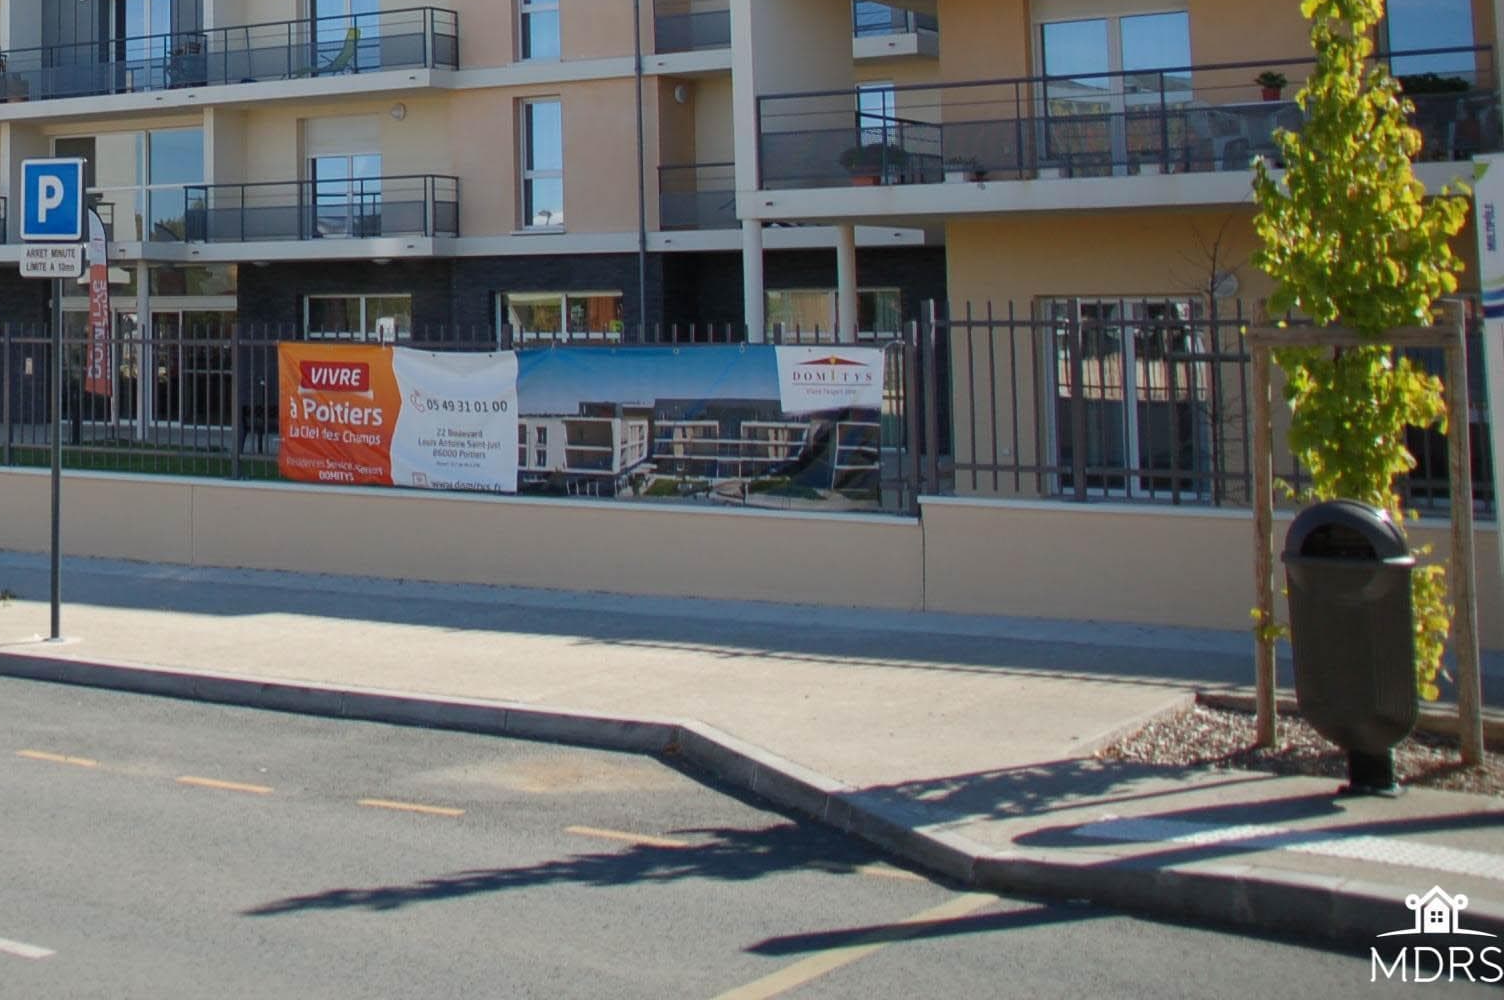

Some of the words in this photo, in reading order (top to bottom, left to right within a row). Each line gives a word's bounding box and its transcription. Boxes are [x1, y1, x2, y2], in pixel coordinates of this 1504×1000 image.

[38, 175, 64, 223] P
[26, 248, 47, 258] ARRET
[51, 248, 75, 258] MINUTE
[311, 367, 361, 386] VIVRE
[792, 368, 872, 382] DOMITYS
[290, 396, 298, 419] à
[302, 398, 383, 426] Poitiers
[426, 399, 439, 410] 05
[442, 400, 455, 411] 49
[458, 400, 471, 413] 31
[474, 400, 489, 413] 01
[492, 400, 508, 413] 00
[289, 425, 299, 438] La
[342, 430, 381, 446] Champs
